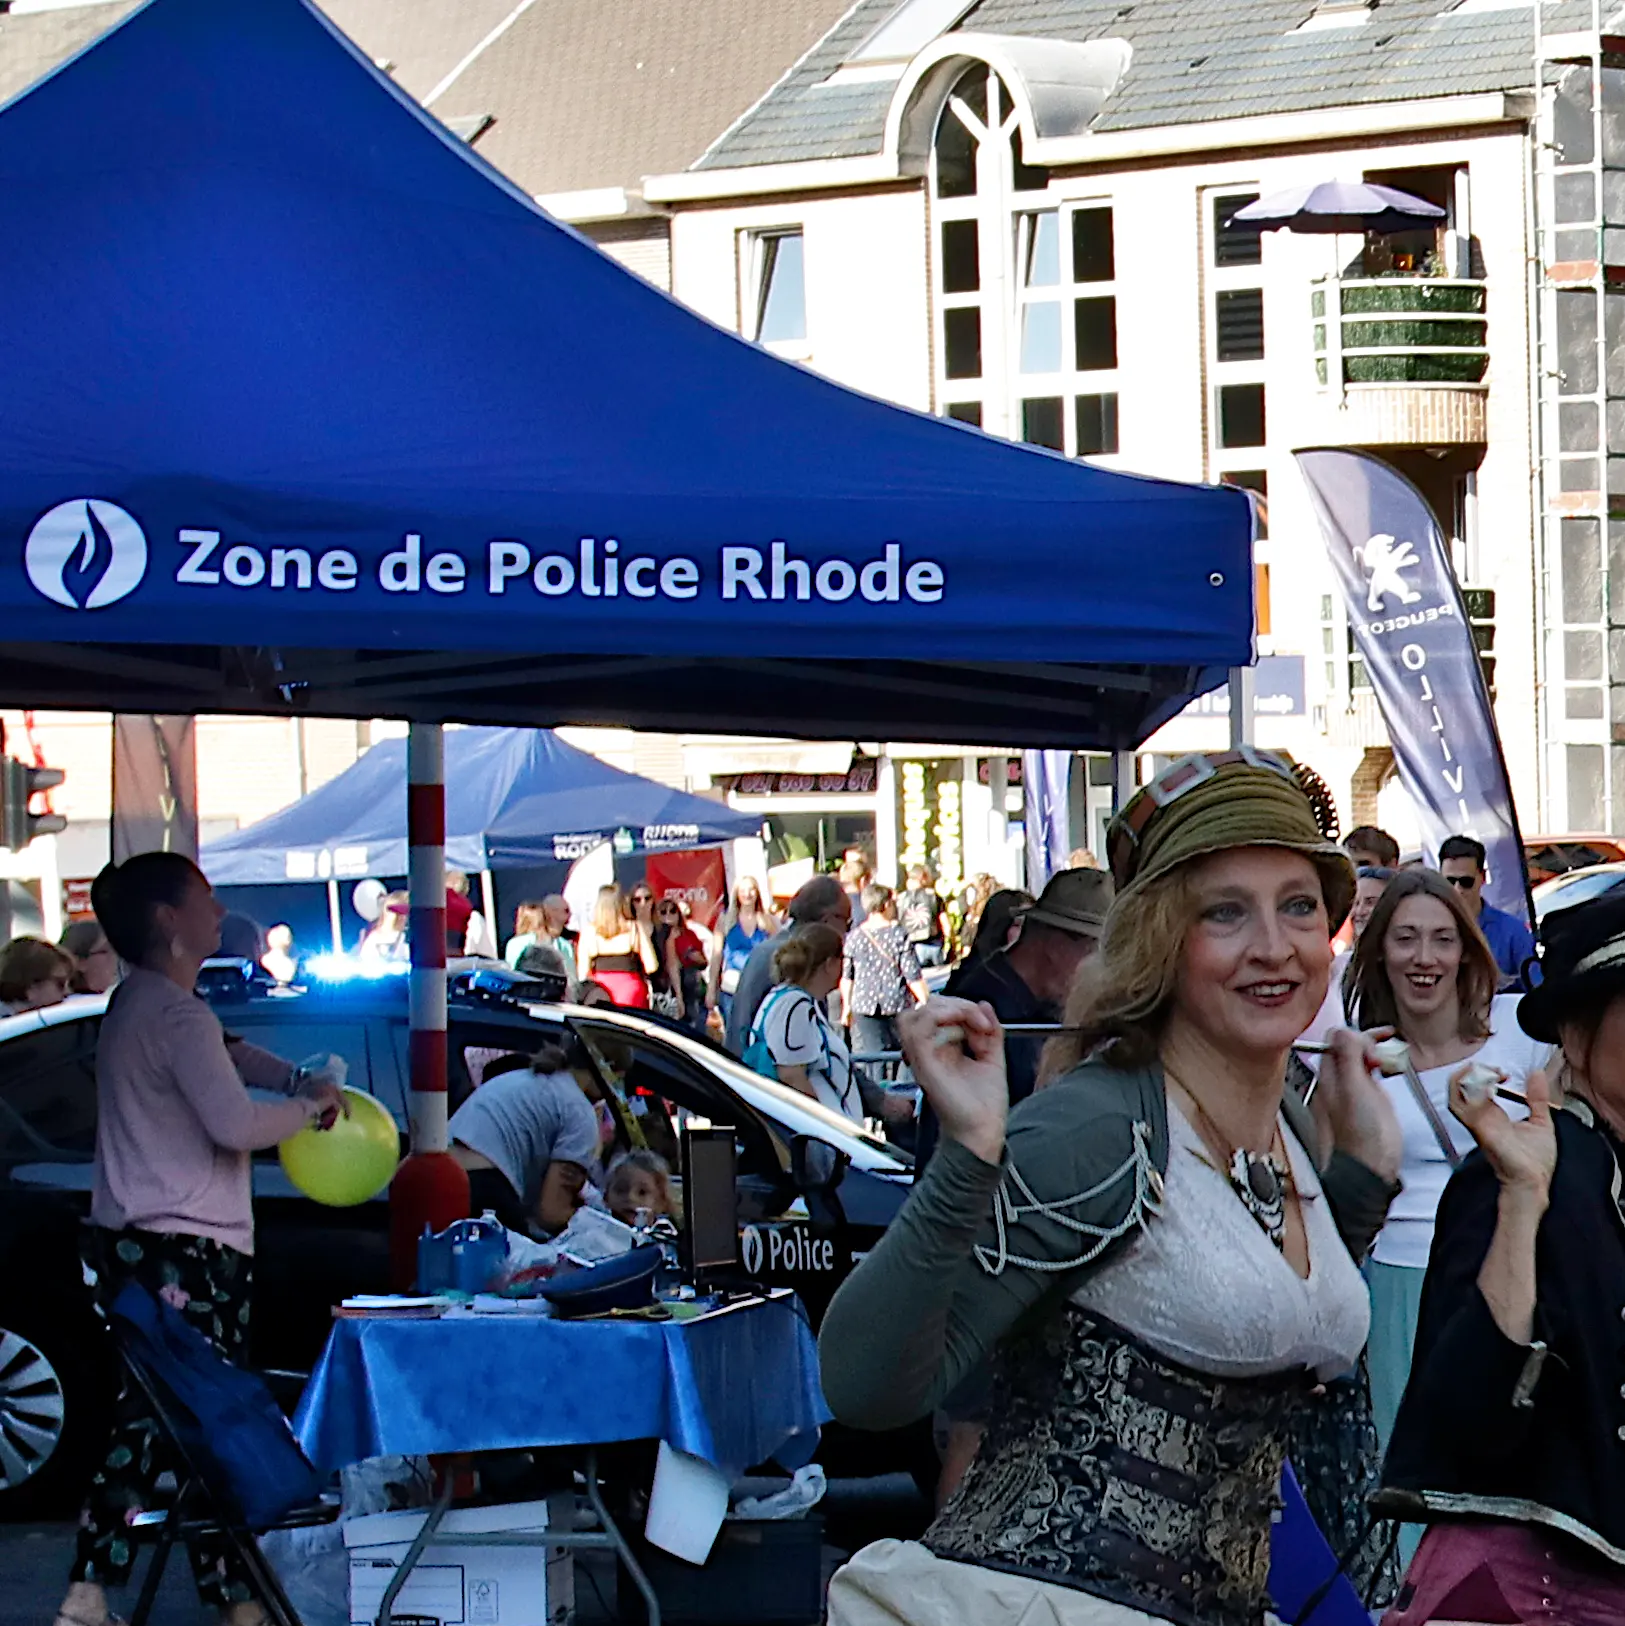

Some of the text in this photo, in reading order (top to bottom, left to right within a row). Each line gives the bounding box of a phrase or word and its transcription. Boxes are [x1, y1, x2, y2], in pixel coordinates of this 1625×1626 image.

[176, 529, 944, 602] Zone de Police Rhode
[768, 1226, 834, 1271] Police
